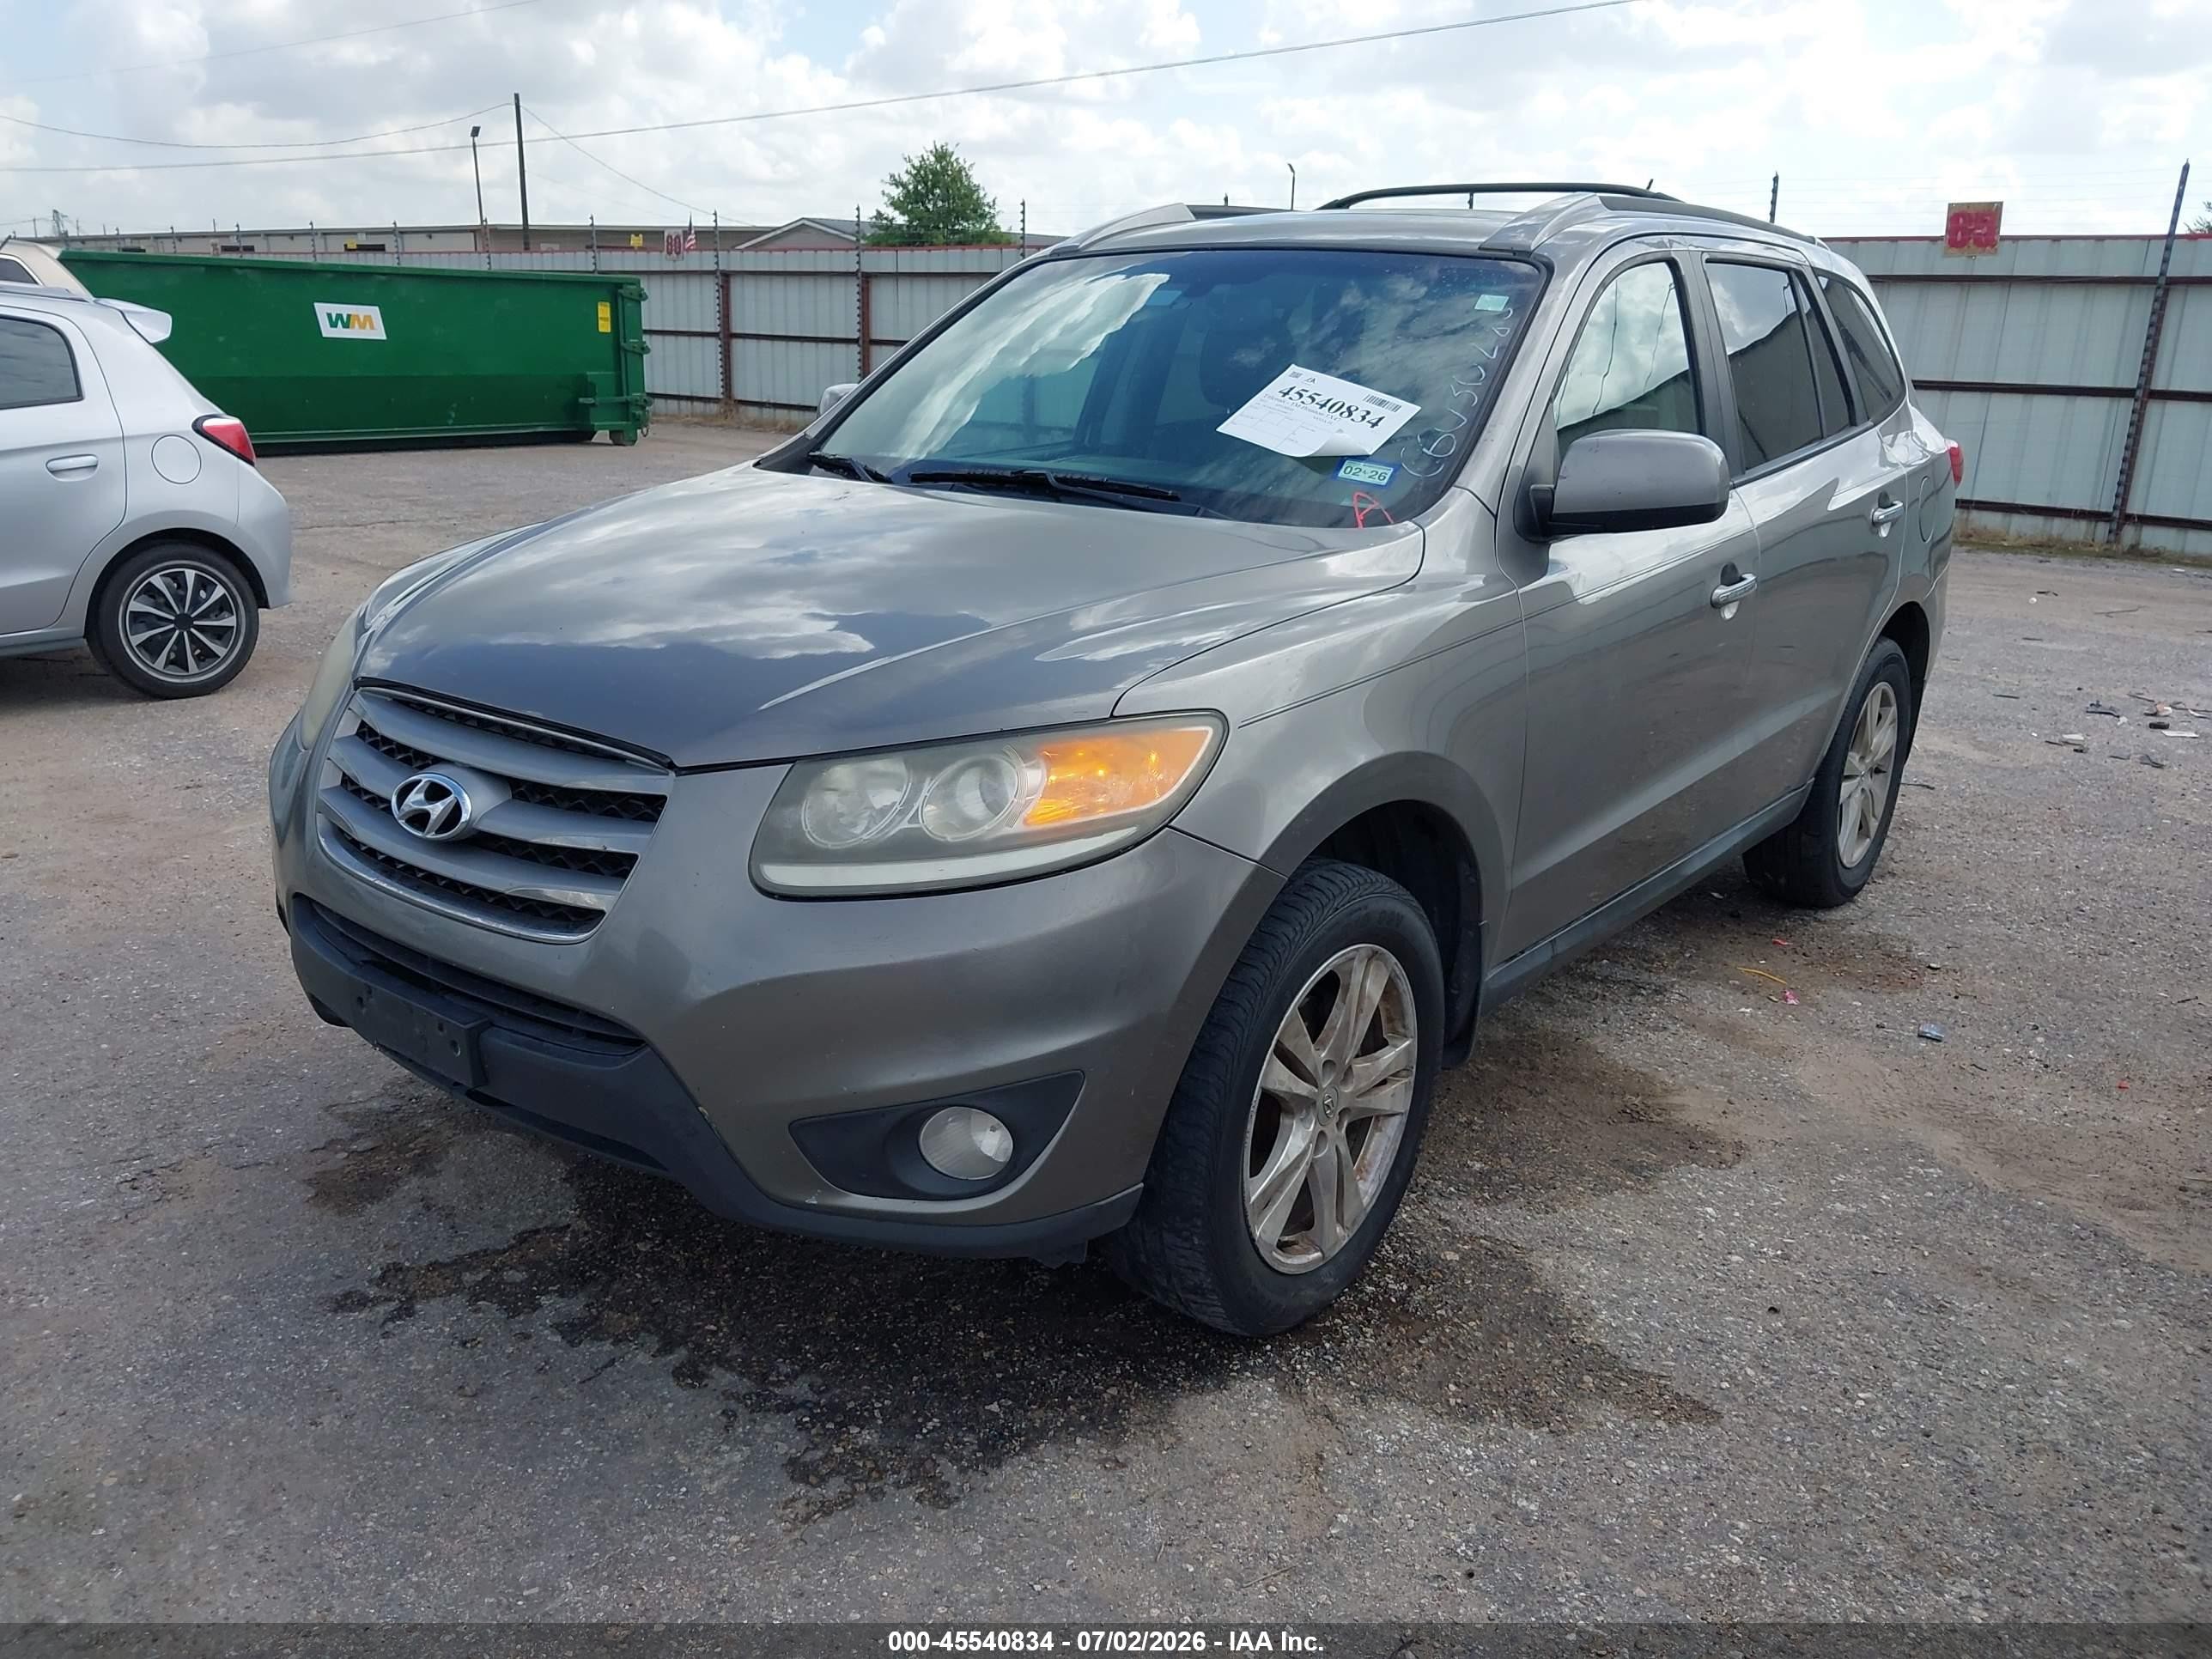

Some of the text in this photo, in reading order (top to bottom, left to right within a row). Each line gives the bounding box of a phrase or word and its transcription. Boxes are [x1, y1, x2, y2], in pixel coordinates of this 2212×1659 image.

[326, 313, 376, 330] WM
[1278, 386, 1386, 428] 45540834
[1343, 465, 1389, 481] 02 26
